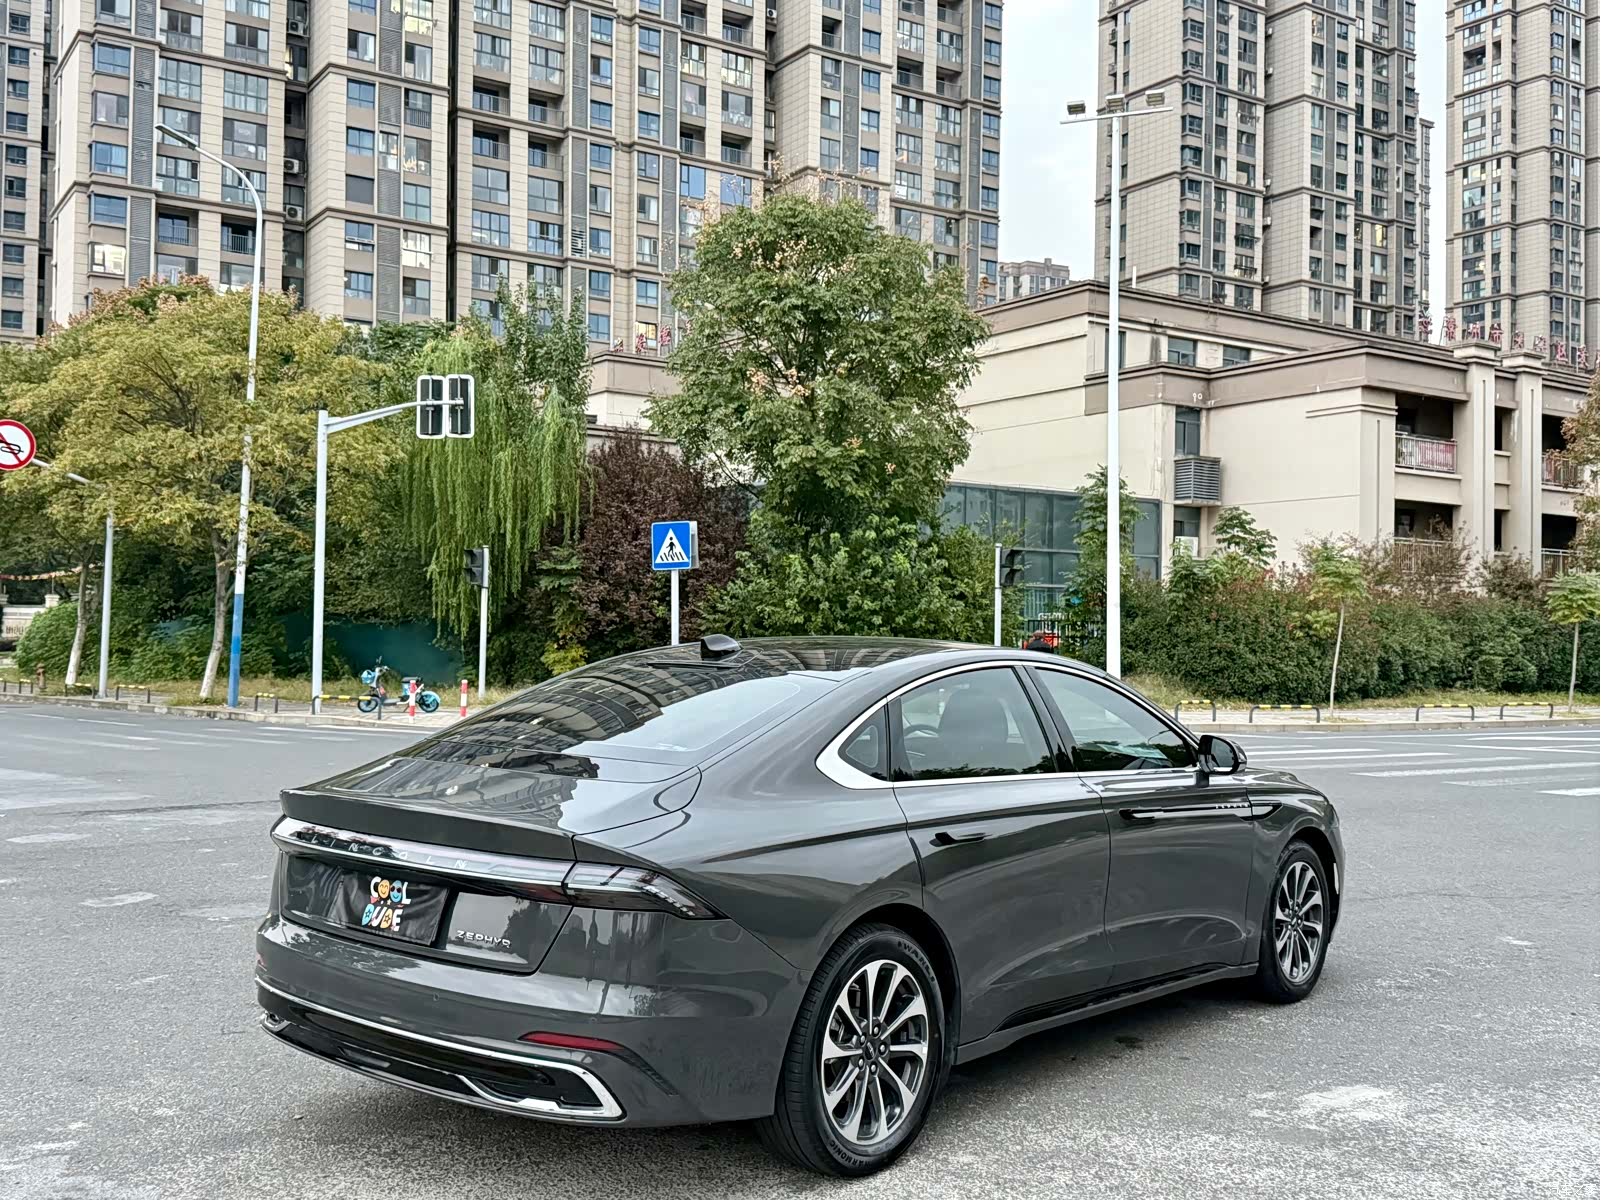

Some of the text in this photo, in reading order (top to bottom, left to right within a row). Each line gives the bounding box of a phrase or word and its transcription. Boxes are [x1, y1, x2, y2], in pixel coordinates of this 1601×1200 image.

[310, 833, 468, 869] LINCOLN
[370, 876, 411, 904] COOL
[361, 904, 403, 931] DUDE
[456, 930, 511, 948] ZEPHYR
